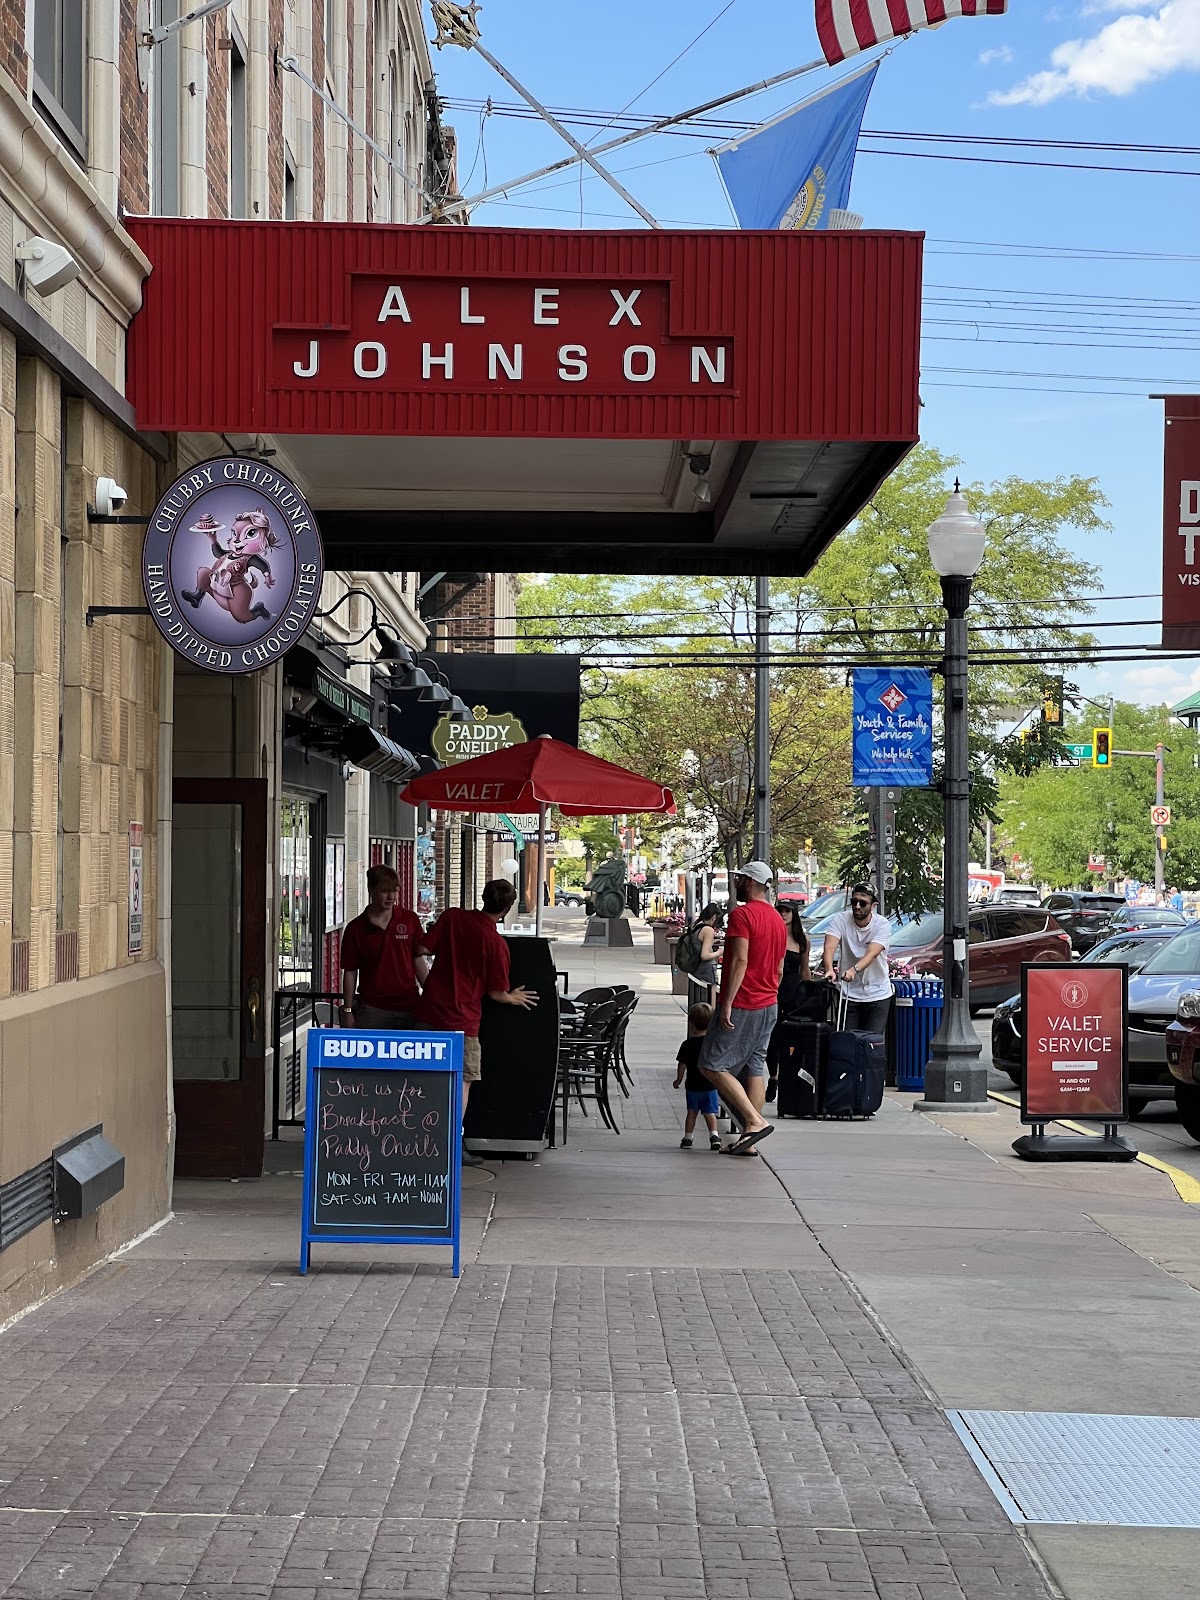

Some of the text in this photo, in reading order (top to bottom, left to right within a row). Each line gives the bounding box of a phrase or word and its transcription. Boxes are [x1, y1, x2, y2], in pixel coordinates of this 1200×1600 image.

[377, 285, 642, 327] ALEX
[293, 340, 726, 383] JOHNSON
[156, 463, 312, 535] CHUBBY CHIPMUNK
[148, 563, 318, 667] HAND-DIPPED CHOCOLATES
[448, 724, 511, 740] PADDY
[857, 713, 929, 734] Youth & Family
[871, 729, 914, 742] Services
[871, 749, 883, 759] We
[883, 747, 898, 763] help
[1073, 746, 1085, 756] ST
[445, 782, 505, 800] VALET
[1047, 1016, 1102, 1031] VALET
[323, 1039, 446, 1060] BUD LIGHT
[1038, 1037, 1112, 1053] SERVICE
[327, 1078, 426, 1113] Join us for
[320, 1104, 440, 1136] Breakfast @
[320, 1134, 371, 1171] Paddy
